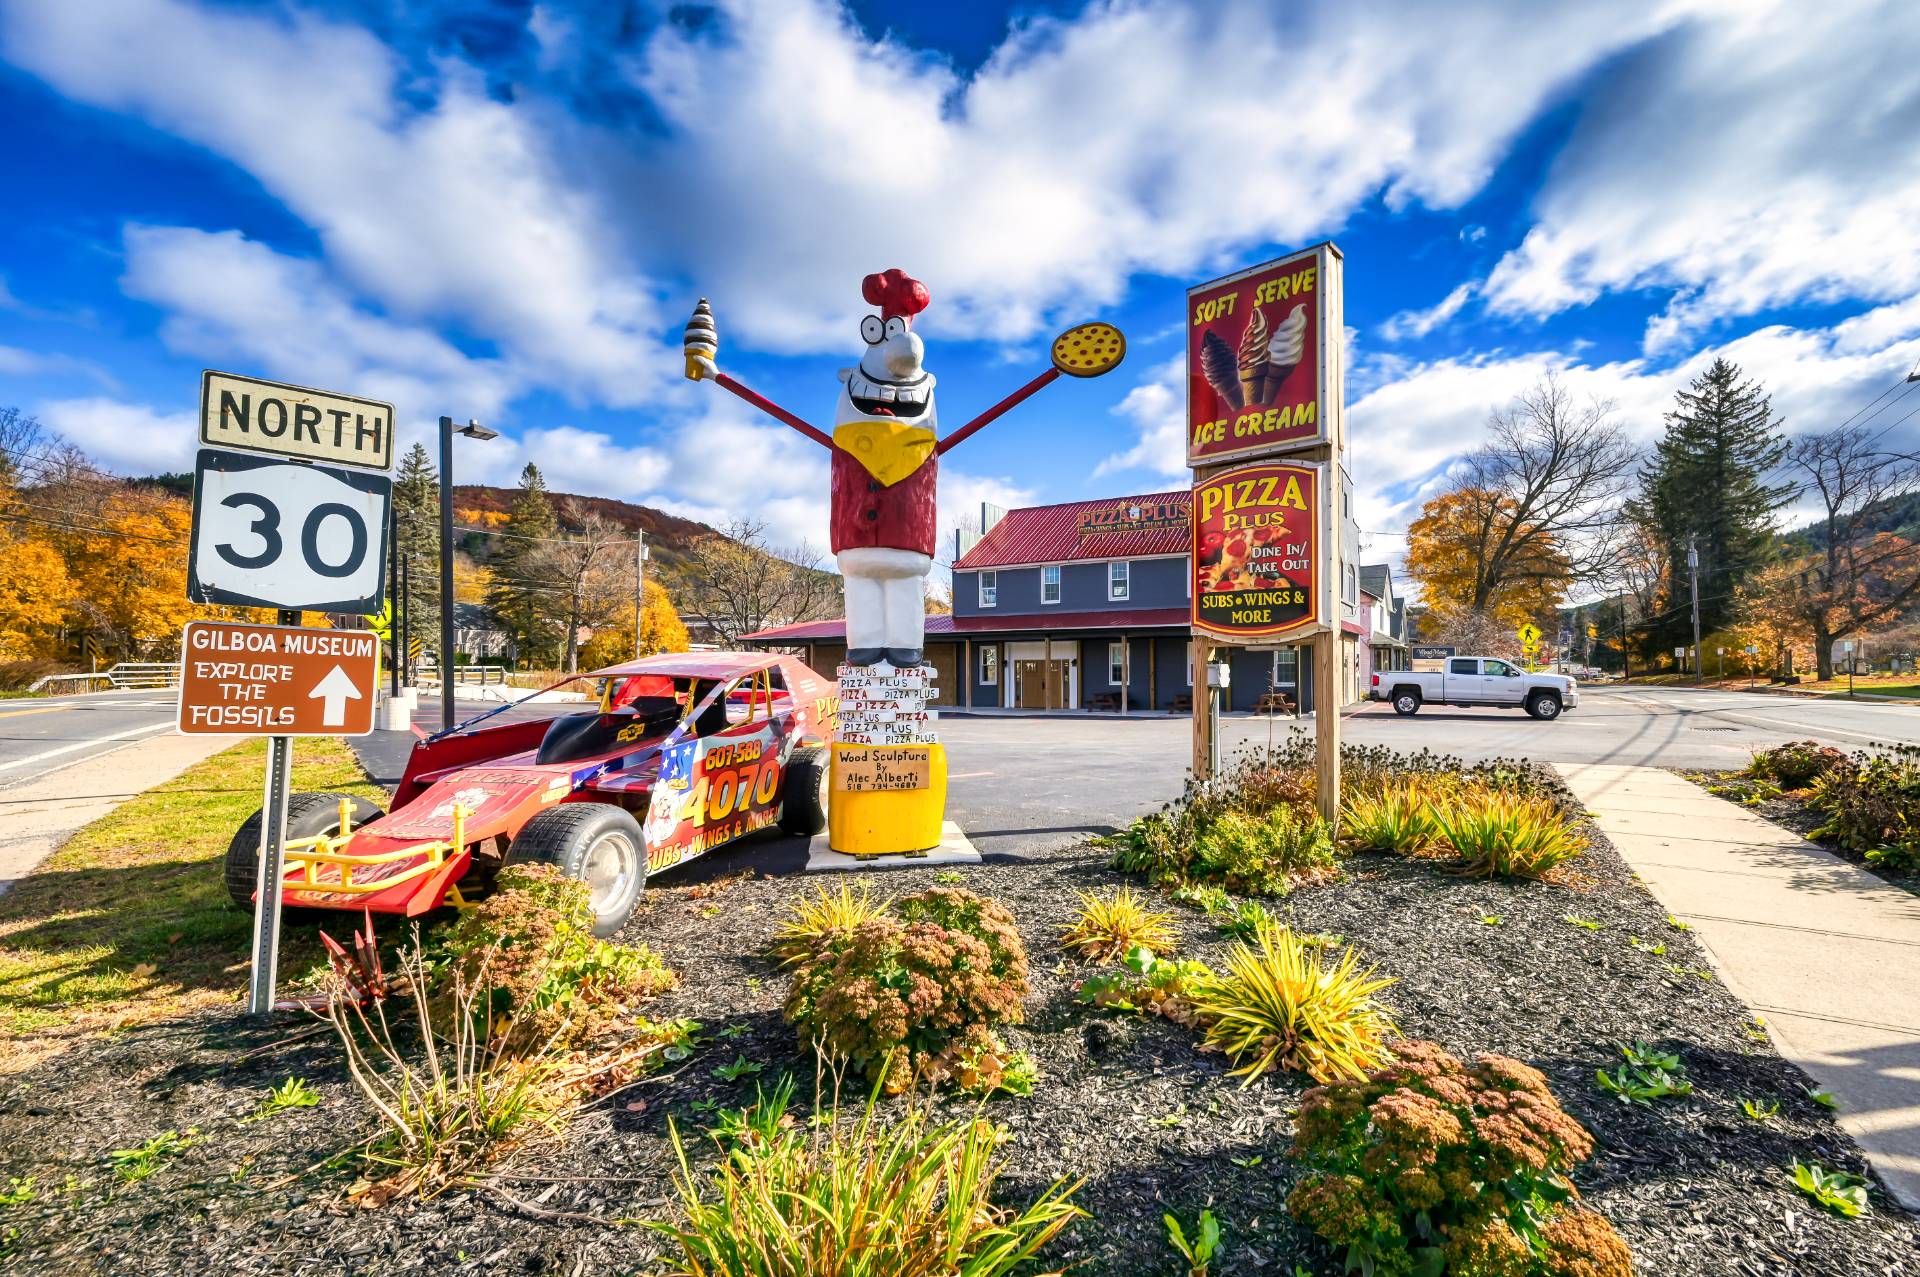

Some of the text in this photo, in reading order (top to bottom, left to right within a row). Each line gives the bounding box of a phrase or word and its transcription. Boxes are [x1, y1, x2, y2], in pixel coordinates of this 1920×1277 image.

[1193, 267, 1316, 326] SOFT SERVE
[219, 390, 382, 453] NORTH
[1193, 401, 1316, 447] ICE CREAM
[1200, 475, 1308, 524] PIZZA
[1080, 503, 1192, 527] PIZZA PLUS
[1223, 511, 1286, 532] PLUS
[214, 492, 368, 578] 30
[1202, 590, 1305, 608] SUBS WINGS &
[1232, 609, 1272, 624] MORE
[192, 629, 373, 657] GILBOA MUSEUM
[194, 661, 294, 682] EXPLORE
[855, 667, 877, 676] PLUS
[894, 669, 927, 677] PIZZA
[218, 683, 266, 700] THE
[841, 679, 908, 688] PIZZA PLUS
[840, 689, 935, 700] PIZZA PIZZA PLUS
[855, 702, 900, 711] PIZZA
[188, 705, 295, 728] FOSSILS
[836, 712, 929, 723] PIZZA PLUS PIZZA
[844, 723, 912, 734] PIZZA PLUS
[842, 733, 936, 744] PIZZA PIZZA PLUS
[705, 739, 762, 771] 607-588
[839, 750, 927, 765] Wood Sculpture
[876, 763, 888, 773] By
[847, 772, 918, 783] Alec Alberti
[680, 760, 781, 828] 4070
[847, 783, 862, 791] 518
[646, 842, 682, 874] SUBS
[691, 824, 731, 855] WINGS
[734, 820, 742, 838] &
